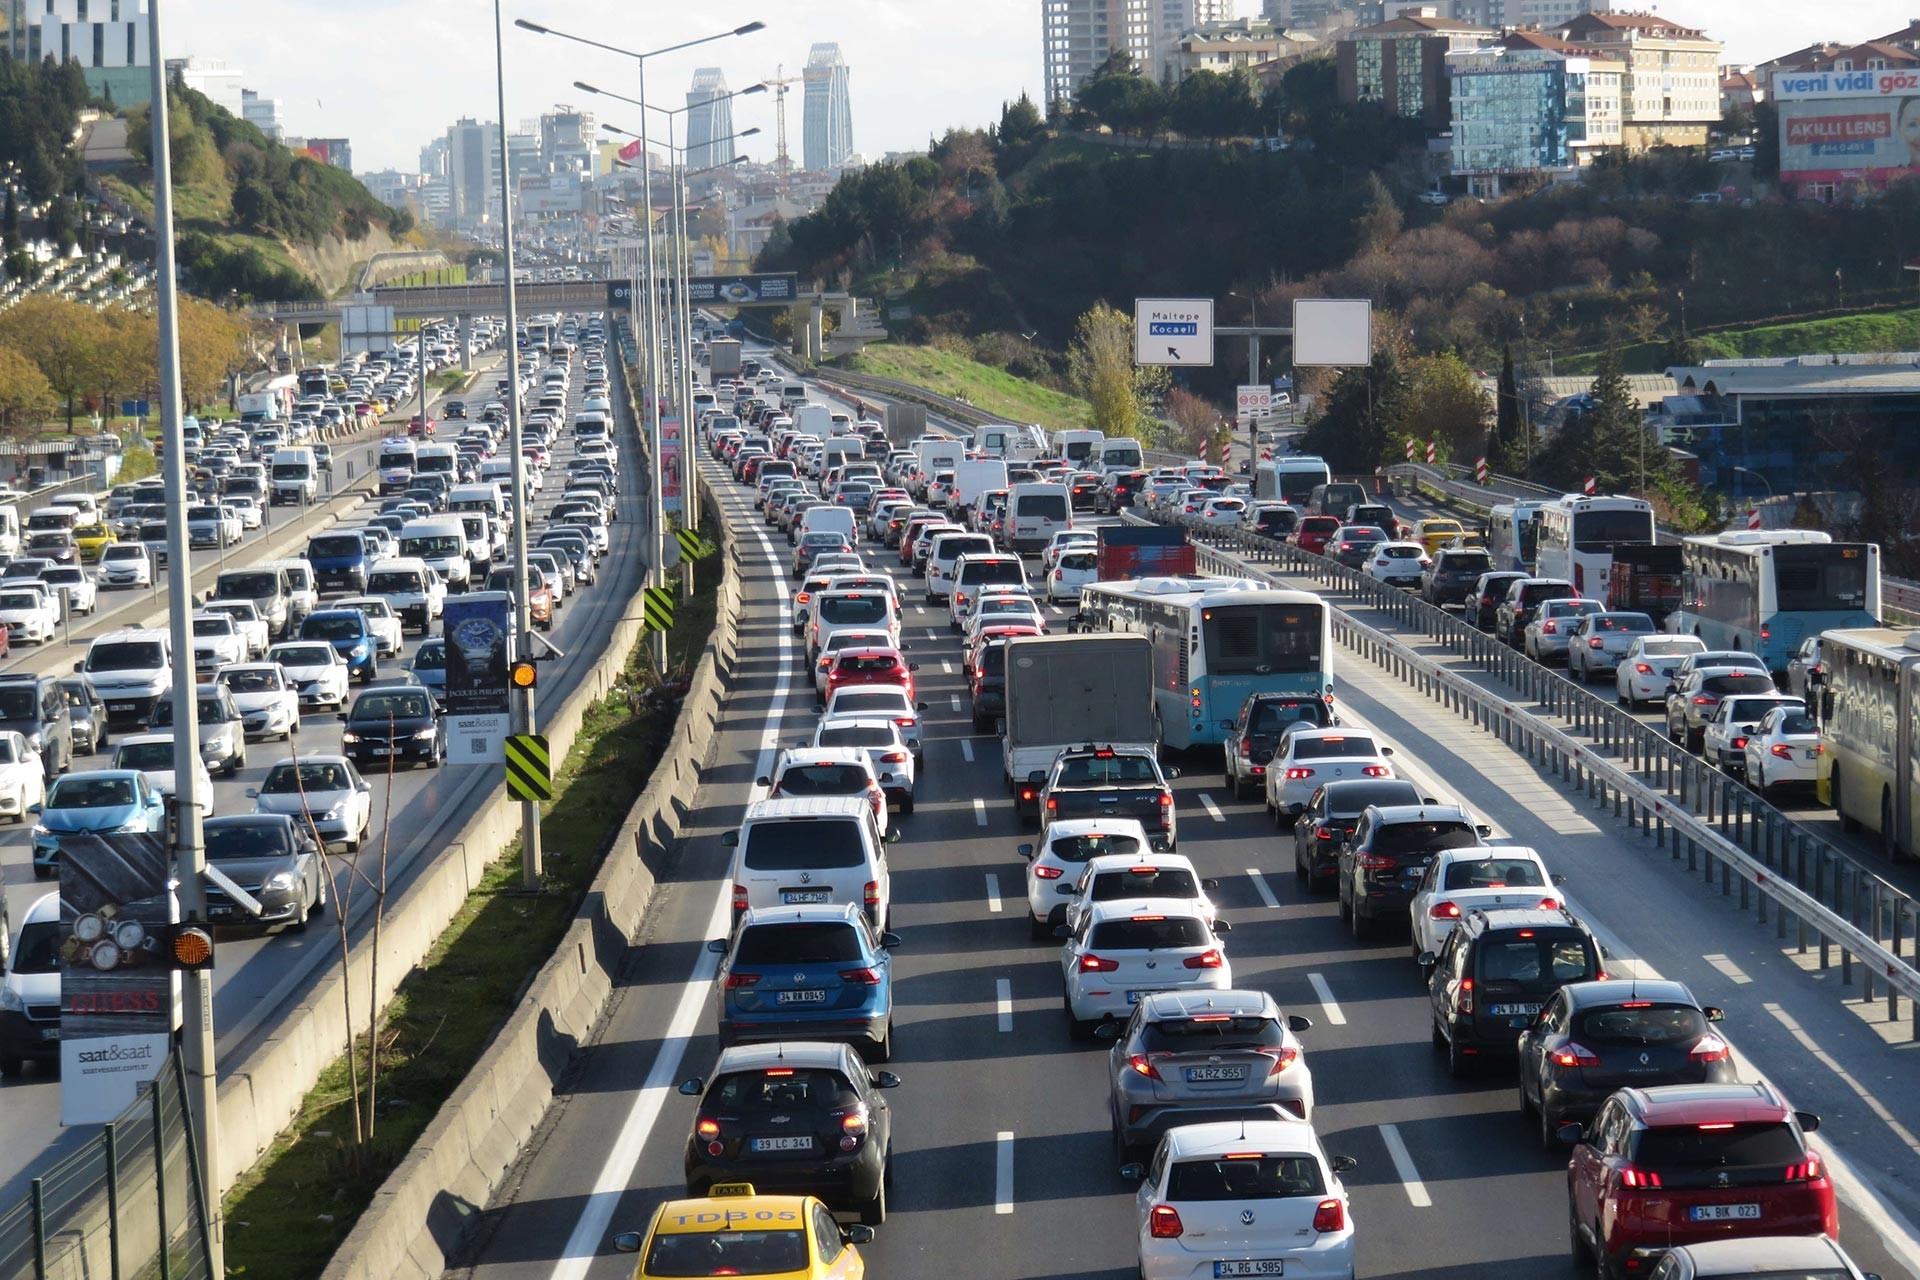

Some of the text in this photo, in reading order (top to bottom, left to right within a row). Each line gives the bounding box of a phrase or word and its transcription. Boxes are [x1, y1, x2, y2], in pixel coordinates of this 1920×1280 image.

[1782, 71, 1918, 95] veni vidi göz
[1790, 120, 1887, 137] AKILLI LENS
[1152, 312, 1200, 322] Maltepe
[1151, 324, 1196, 334] Kocaeli
[458, 718, 499, 729] saat&saat
[780, 992, 790, 1001] 34
[804, 990, 824, 1000] 0945
[71, 990, 160, 1015] GUESS
[1495, 1005, 1506, 1015] 34
[78, 1043, 153, 1064] saat&saat
[82, 1063, 149, 1075] saatvesaat.com.tr
[1191, 1067, 1243, 1081] 34 RZ 9551
[760, 1137, 811, 1150] 39 LC 341
[1699, 1205, 1758, 1219] 34 BIK 023
[1221, 1261, 1281, 1274] 34 RG 4985
